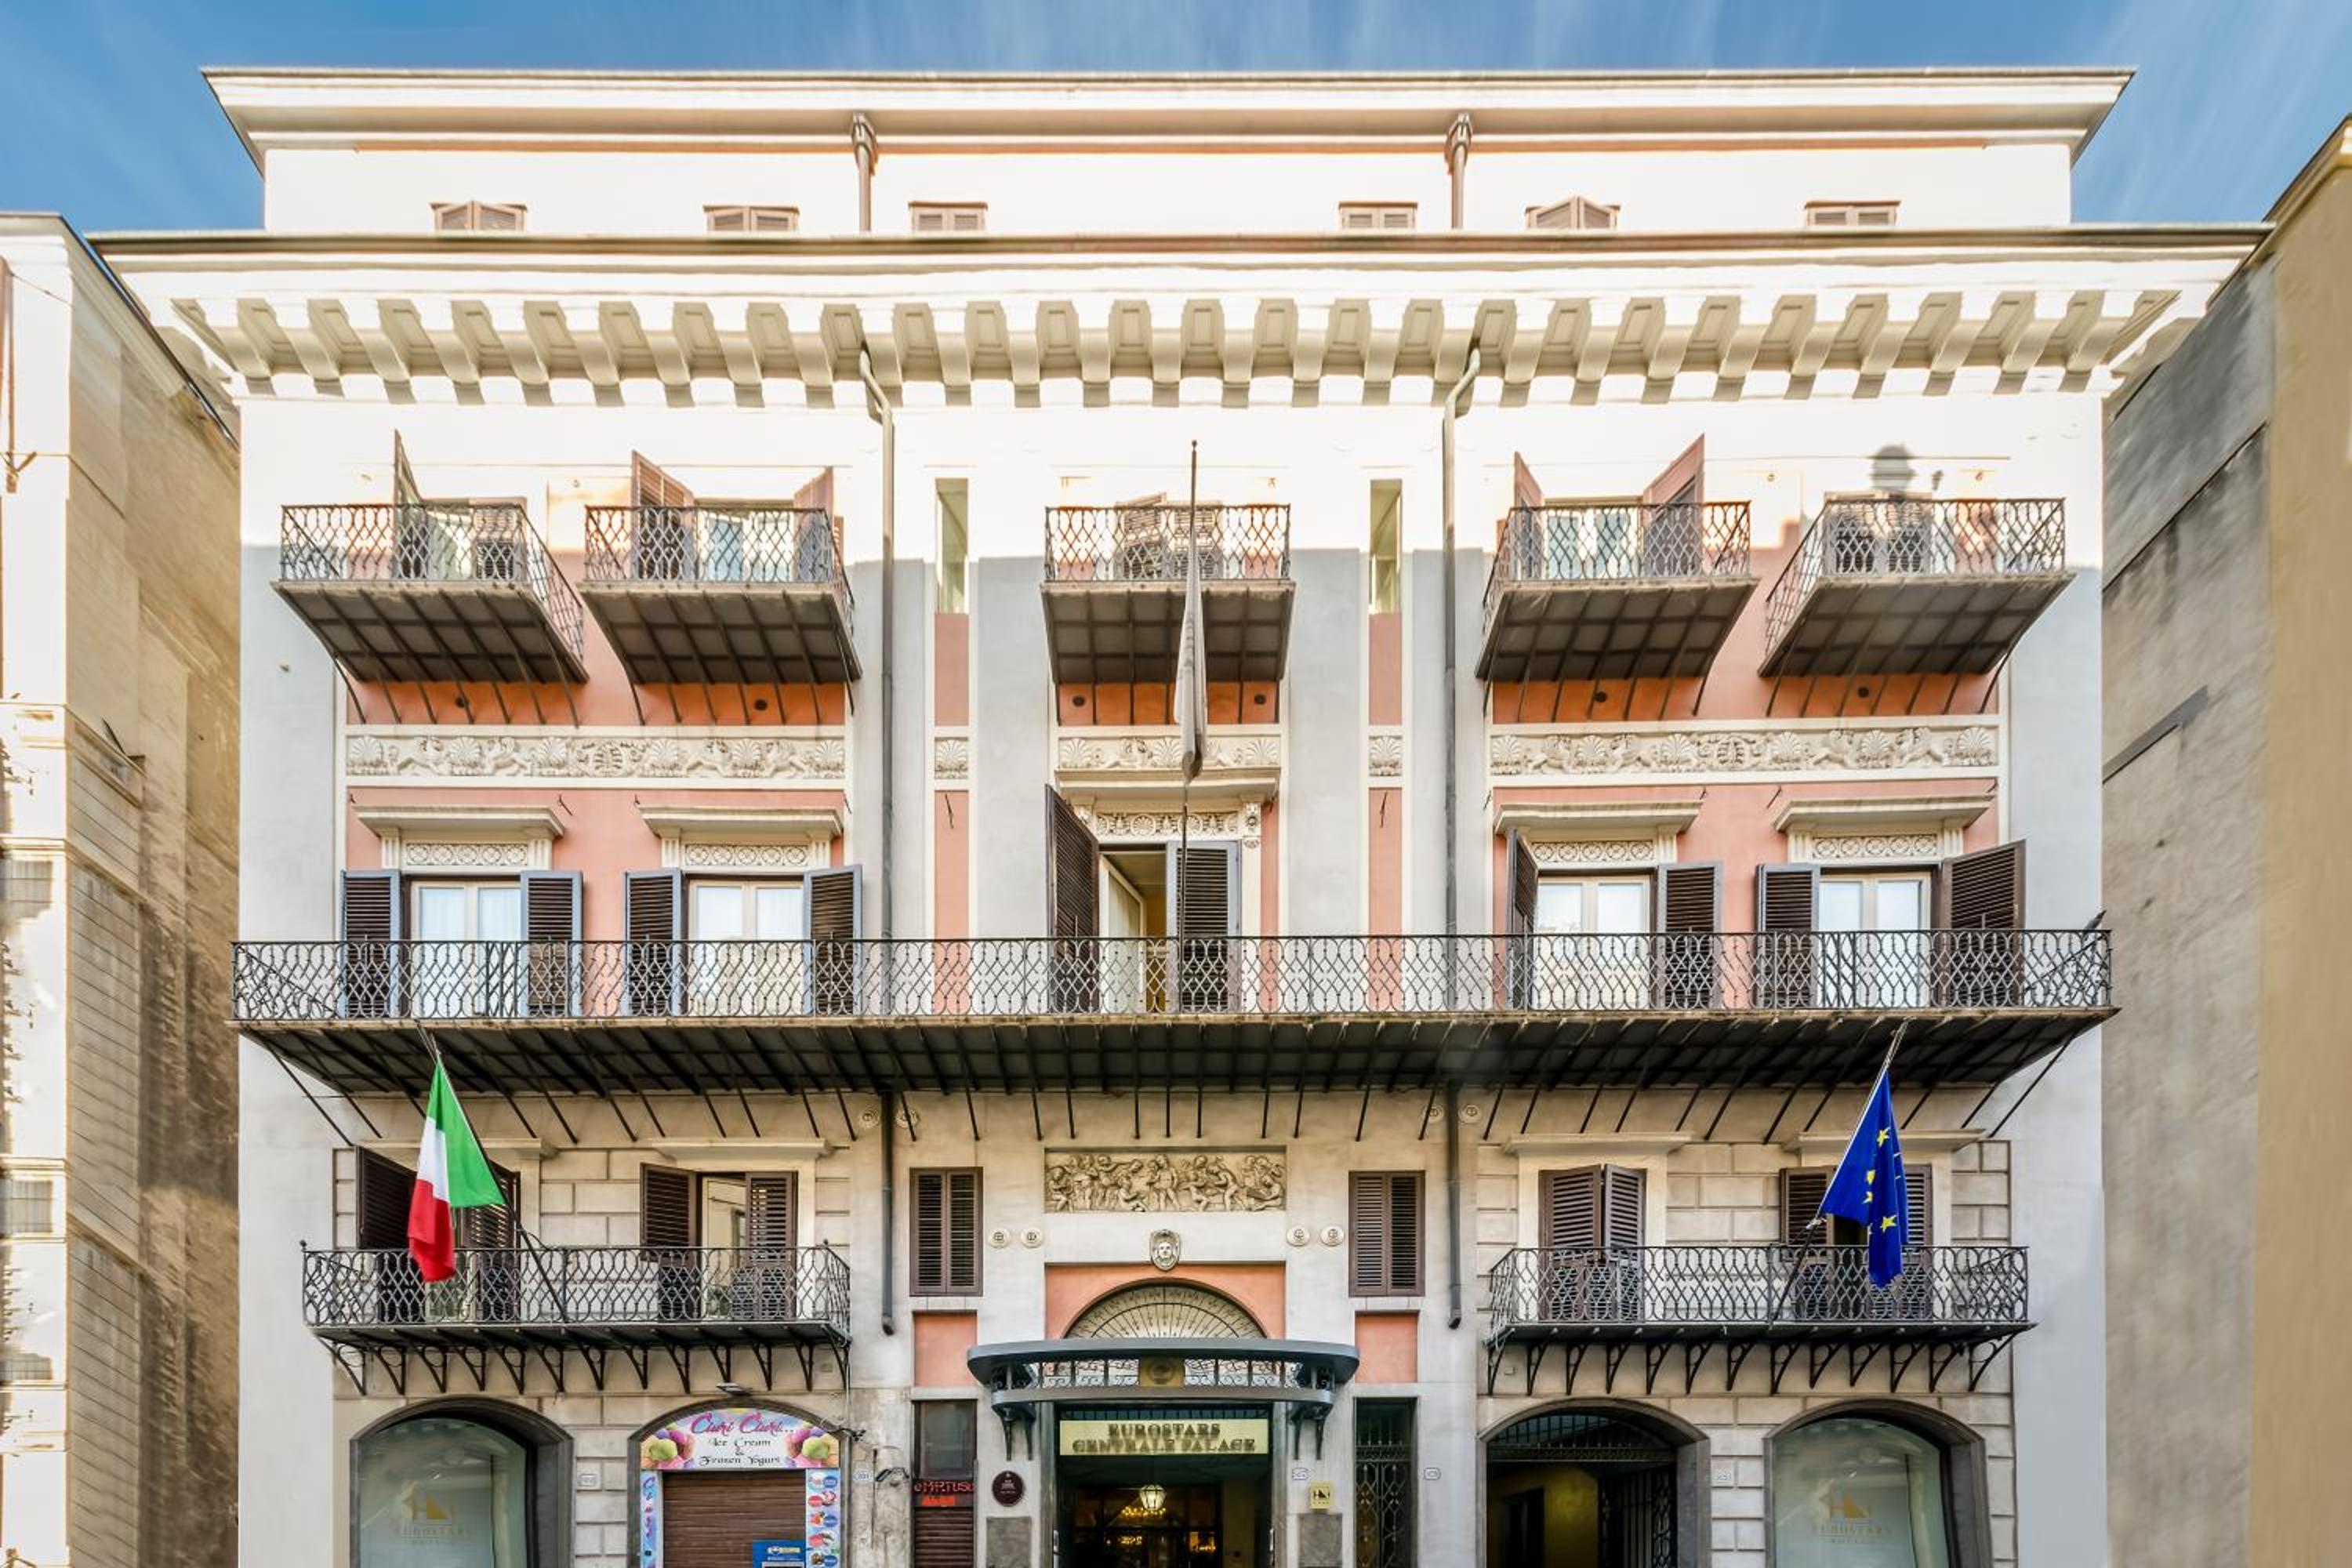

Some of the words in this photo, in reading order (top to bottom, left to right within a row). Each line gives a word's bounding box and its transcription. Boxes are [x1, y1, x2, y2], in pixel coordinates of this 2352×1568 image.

[1109, 1424, 1221, 1436] EUROSTARS
[734, 1436, 771, 1446] Cream
[1072, 1439, 1174, 1452] CENTRALE
[1181, 1438, 1255, 1452] PALACE
[699, 1456, 741, 1466] Frozen
[748, 1455, 780, 1466] Yogurt
